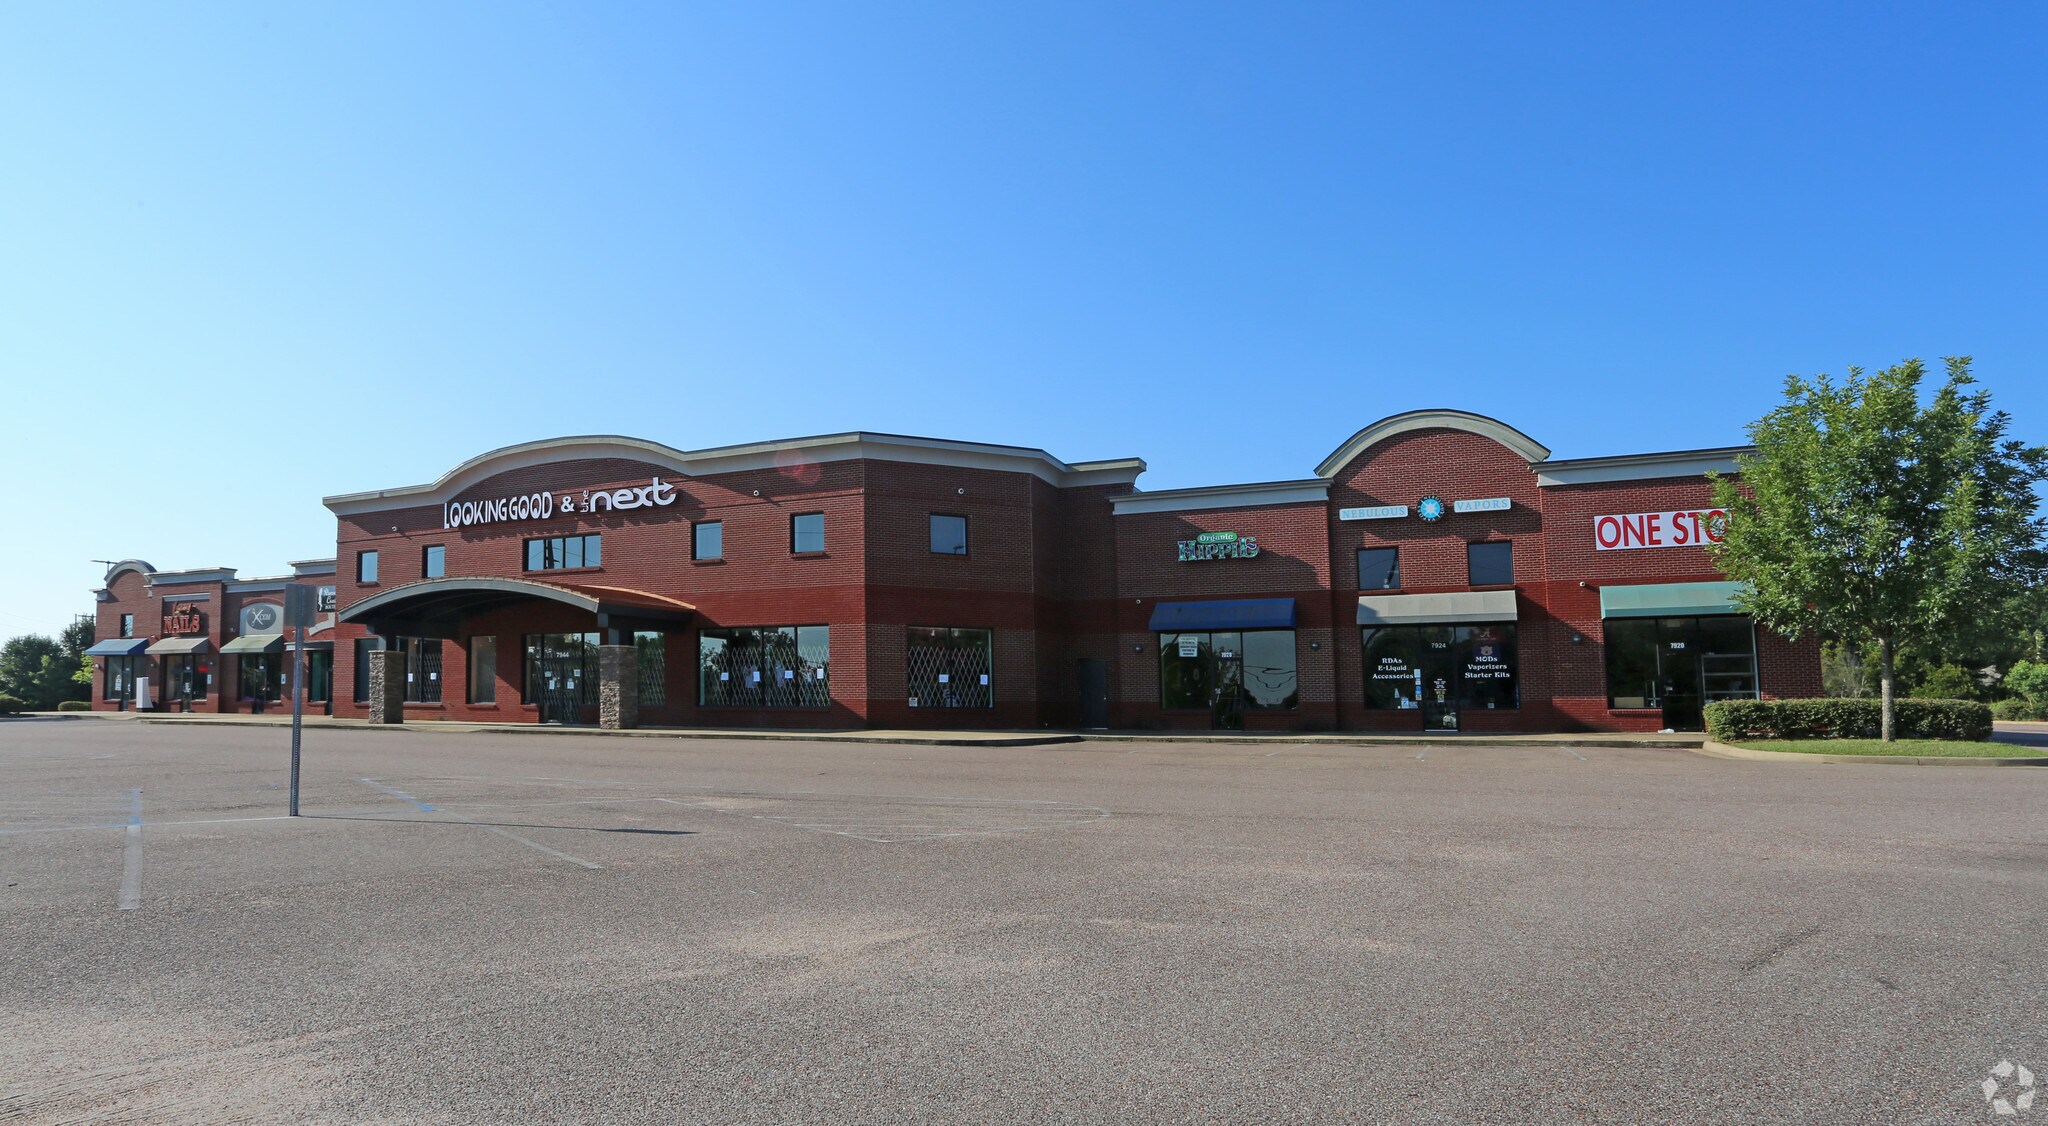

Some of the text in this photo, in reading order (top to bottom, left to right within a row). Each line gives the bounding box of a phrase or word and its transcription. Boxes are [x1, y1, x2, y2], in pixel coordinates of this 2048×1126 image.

[560, 495, 575, 513] &
[590, 476, 677, 513] next
[1456, 499, 1508, 511] VAPORS
[1342, 507, 1405, 519] NEBULOUS
[1200, 533, 1233, 542] Organic
[1597, 514, 1662, 548] ONE
[163, 614, 200, 633] NAILS
